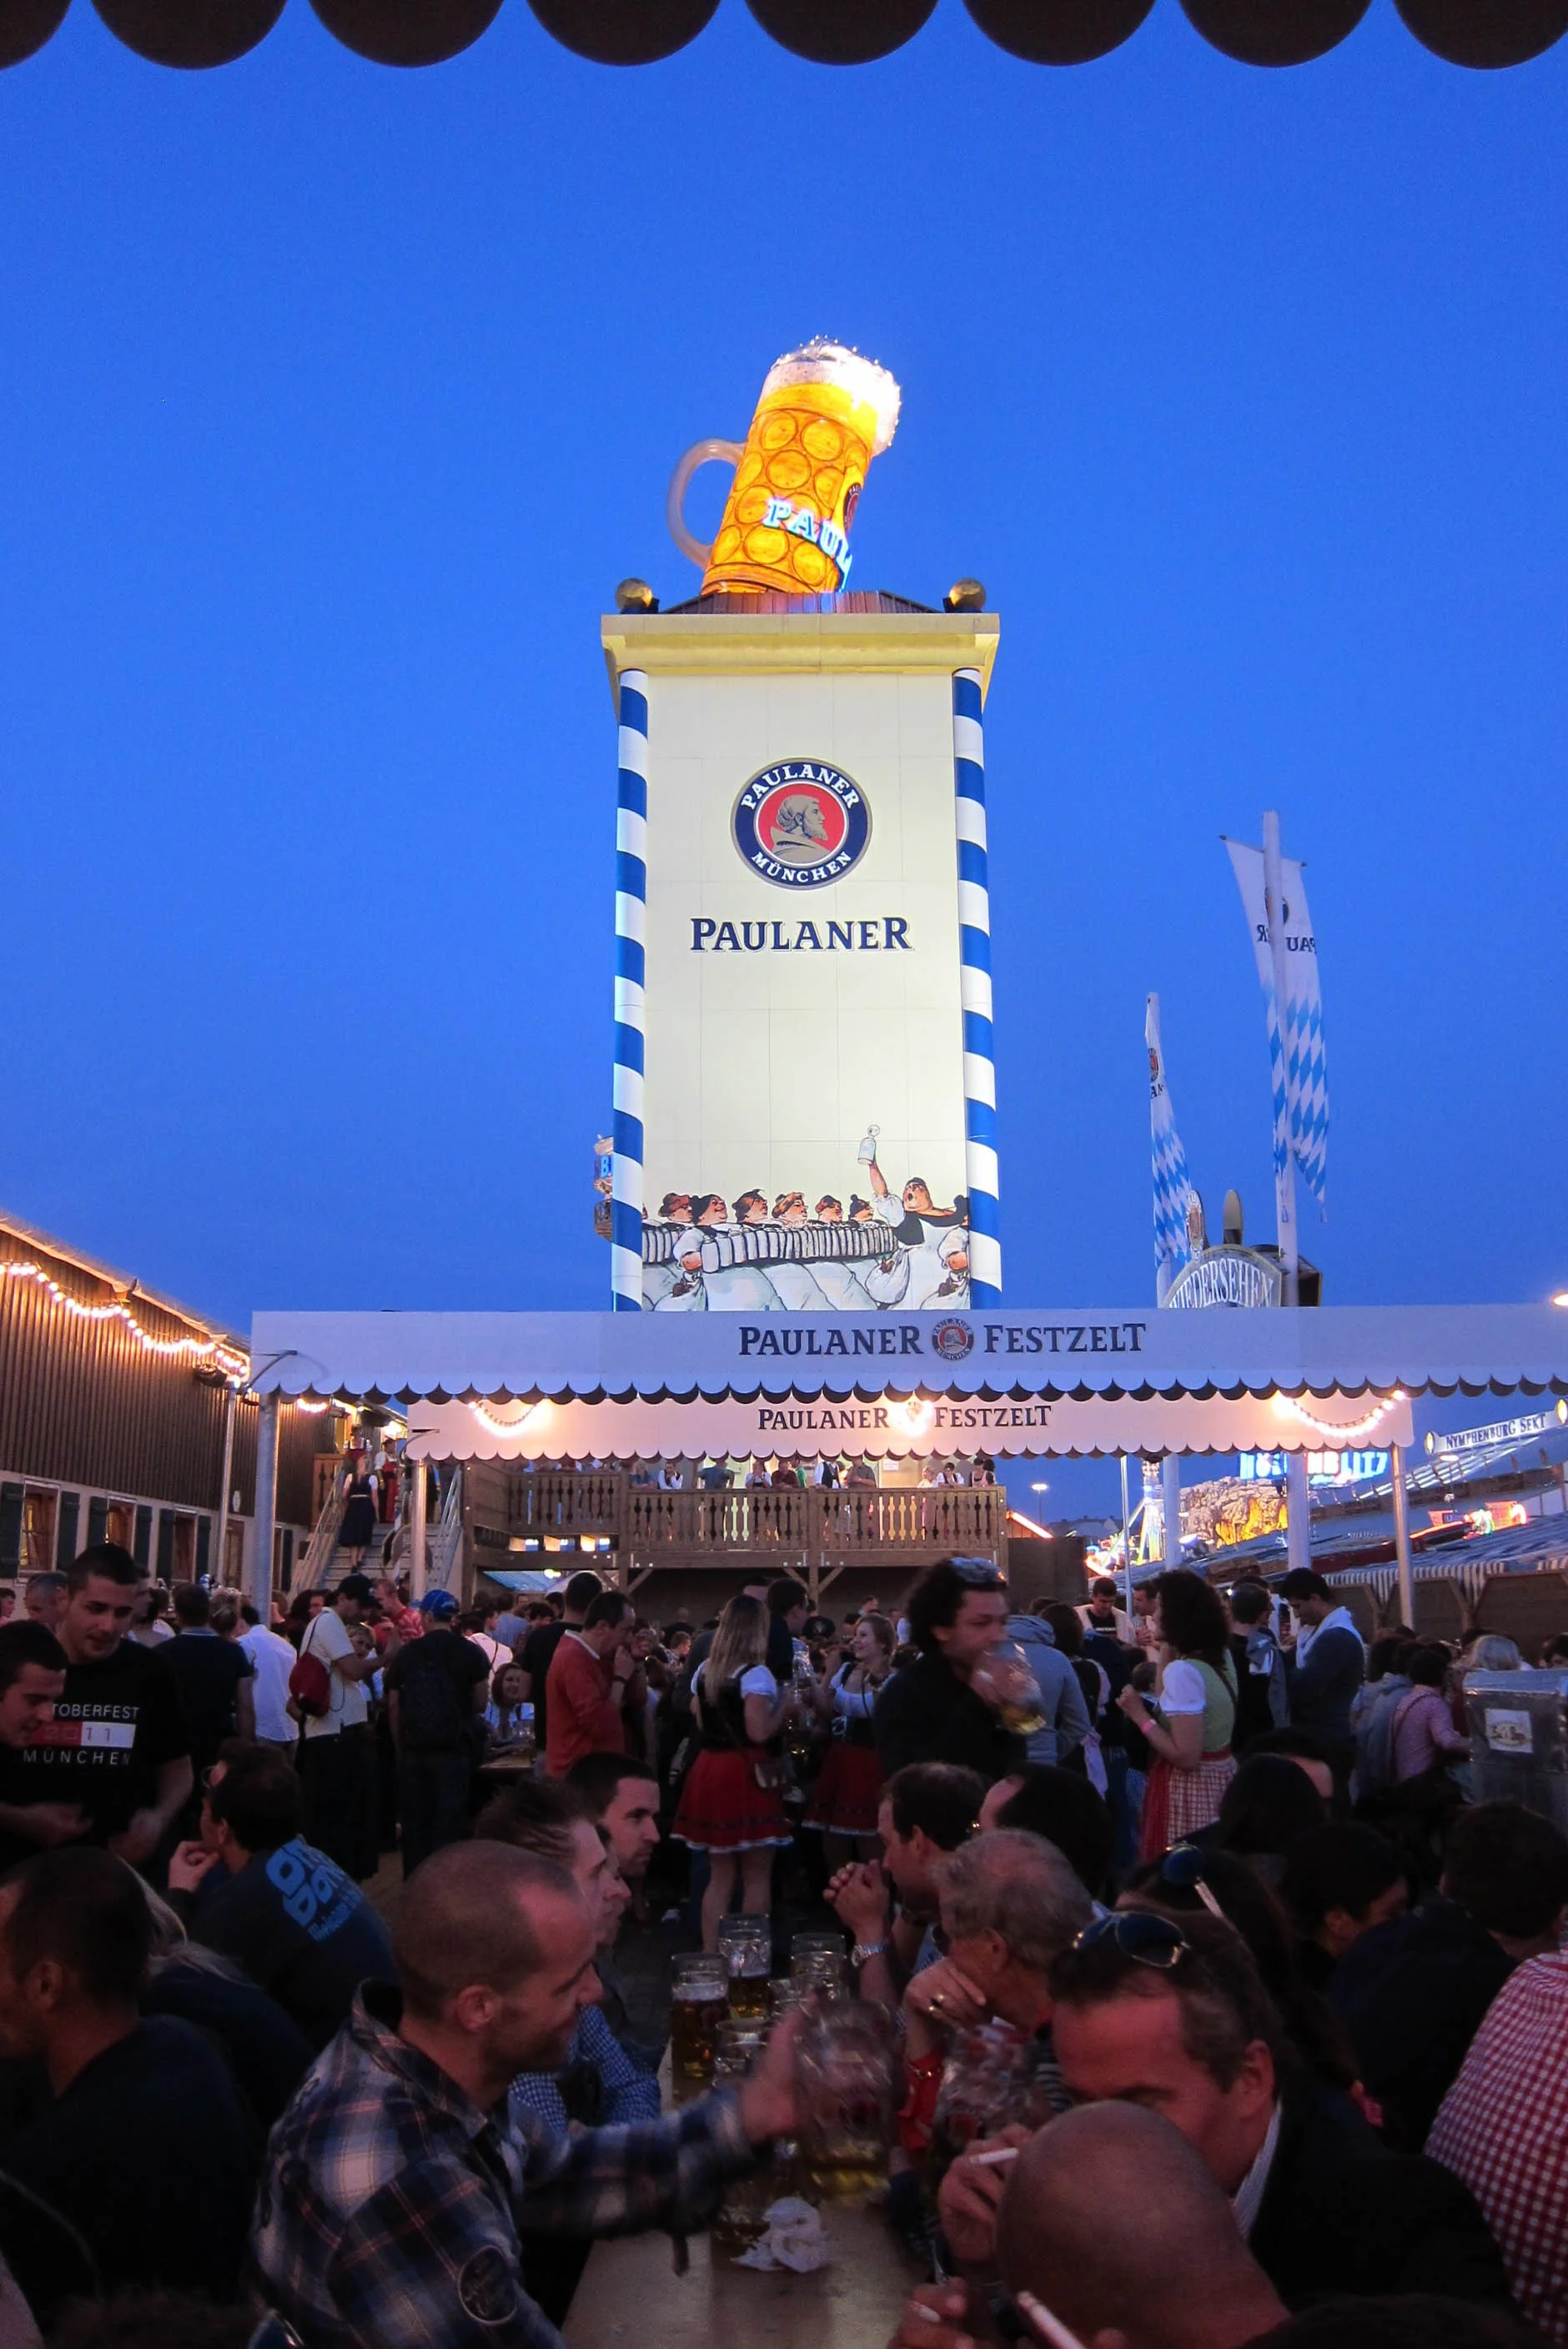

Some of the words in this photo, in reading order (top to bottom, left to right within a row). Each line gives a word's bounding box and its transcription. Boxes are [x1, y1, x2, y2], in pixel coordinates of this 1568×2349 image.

[741, 763, 860, 810] PAULANER
[751, 851, 852, 883] MÜNCHEN
[690, 916, 914, 952] PAULANER
[738, 1325, 924, 1356] PAULANER
[983, 1323, 1146, 1353] FESTZELT
[758, 1407, 890, 1430] PAULANER
[934, 1406, 1052, 1427] FESTZELT
[53, 1703, 140, 1719] TOBERFEST
[23, 1746, 131, 1766] MÜNCHEN
